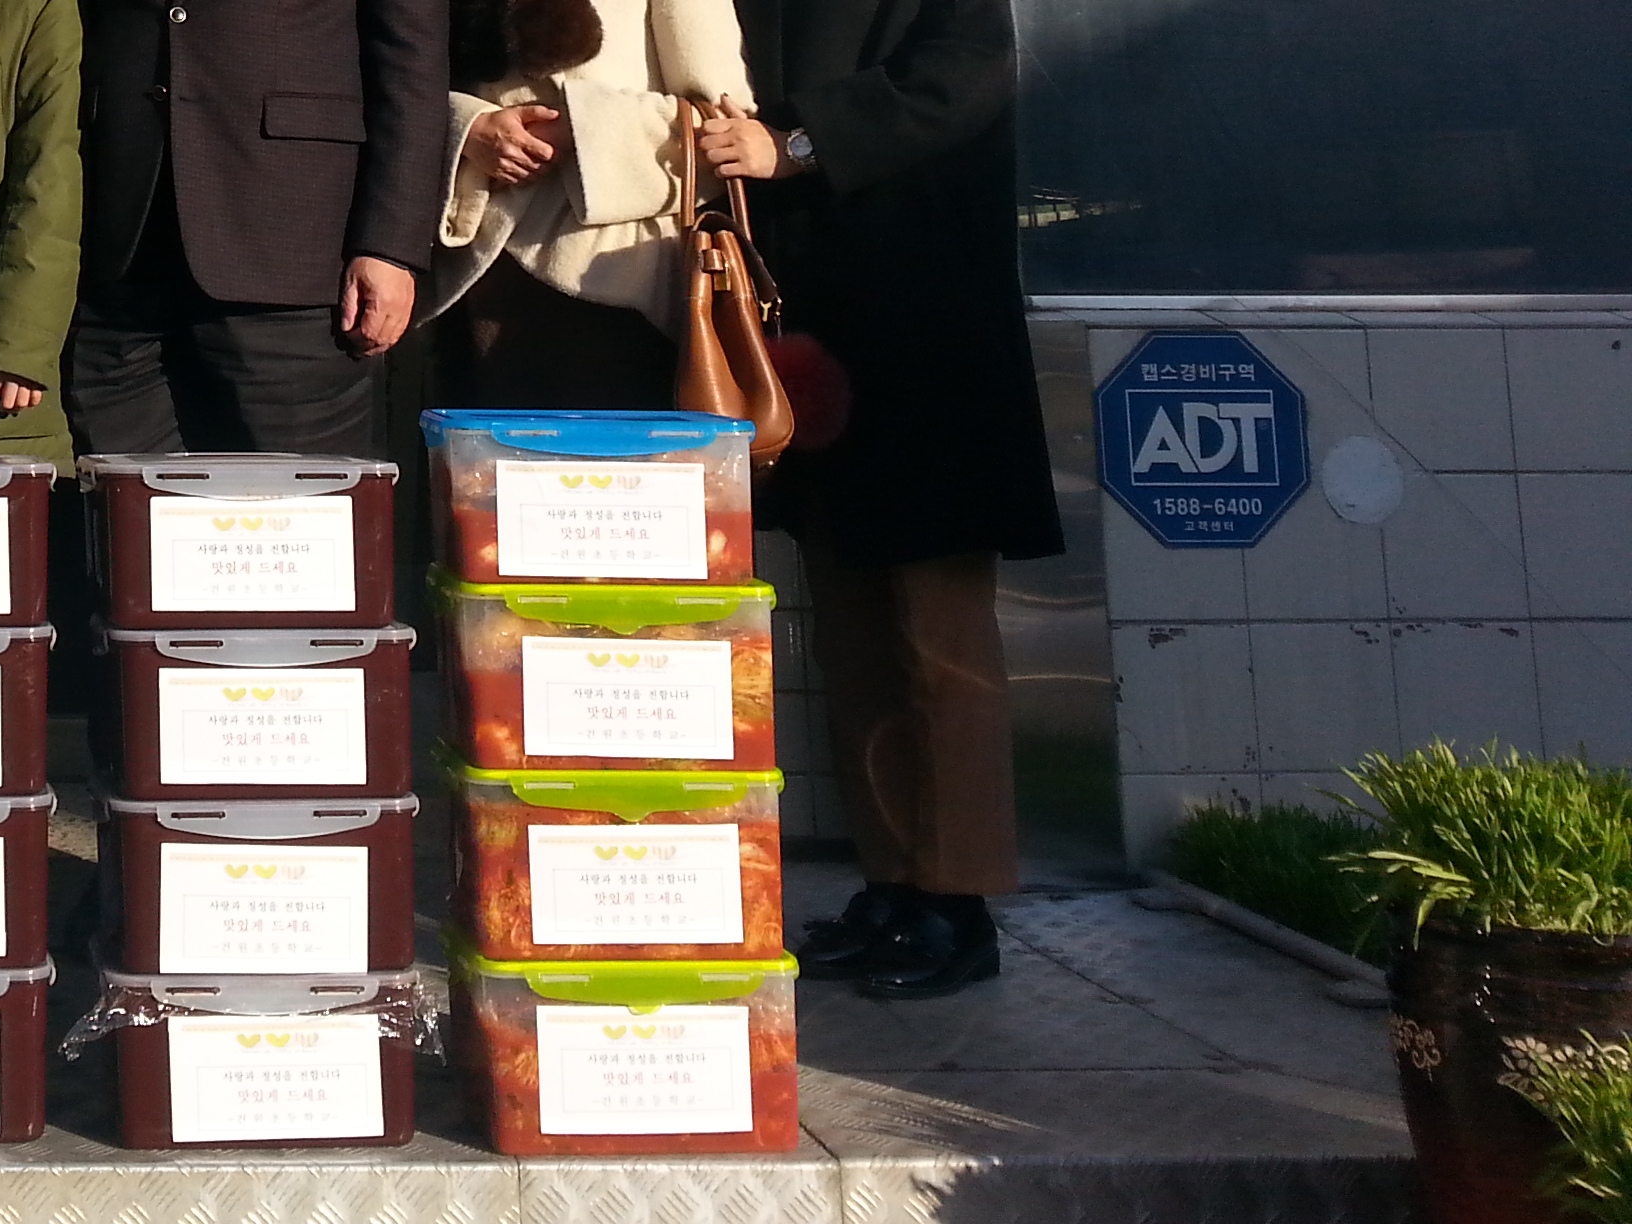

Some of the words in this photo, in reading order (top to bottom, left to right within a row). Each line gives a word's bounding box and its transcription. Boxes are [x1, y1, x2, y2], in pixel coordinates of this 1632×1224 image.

[1141, 363, 1255, 382] 캡스경비구역
[1133, 402, 1274, 473] ADT
[1154, 498, 1262, 515] 1588-6400
[547, 510, 577, 520] 사랑과
[584, 510, 613, 520] 정성을
[621, 510, 662, 521] 전합니다
[1184, 521, 1234, 532] 고객센터
[560, 527, 600, 540] 맛있게
[609, 528, 650, 541] 드세요
[198, 545, 228, 555] 사랑과
[235, 544, 263, 555] 정성을
[271, 544, 310, 555] 전합니다
[211, 562, 250, 575] 맛있게
[258, 562, 298, 574] 드세요
[573, 688, 604, 699] 사랑과
[611, 689, 640, 699] 정성을
[648, 689, 689, 701] 전합니다
[587, 706, 627, 719] 맛있게
[636, 707, 677, 720] 드세요
[208, 715, 238, 725] 사랑과
[246, 715, 274, 725] 정성을
[282, 715, 322, 725] 전합니다
[222, 733, 261, 746] 맛있게
[269, 733, 310, 745] 드세요
[580, 874, 611, 885] 사랑과
[618, 874, 647, 885] 정성을
[655, 873, 696, 885] 전합니다
[594, 892, 634, 905] 맛있게
[643, 892, 685, 905] 드세요
[210, 901, 240, 911] 사랑과
[247, 901, 276, 912] 정성을
[285, 901, 324, 913] 전합니다
[223, 919, 262, 933] 맛있게
[271, 919, 312, 933] 드세요
[588, 1053, 619, 1065] 사랑과
[626, 1053, 656, 1064] 정성을
[664, 1052, 705, 1064] 전합니다
[223, 1071, 254, 1082] 사랑과
[261, 1070, 291, 1081] 정성을
[299, 1069, 340, 1081] 전합니다
[602, 1071, 642, 1086] 맛있게
[651, 1071, 693, 1085] 드세요
[237, 1089, 277, 1103] 맛있게
[286, 1088, 328, 1102] 드세요
